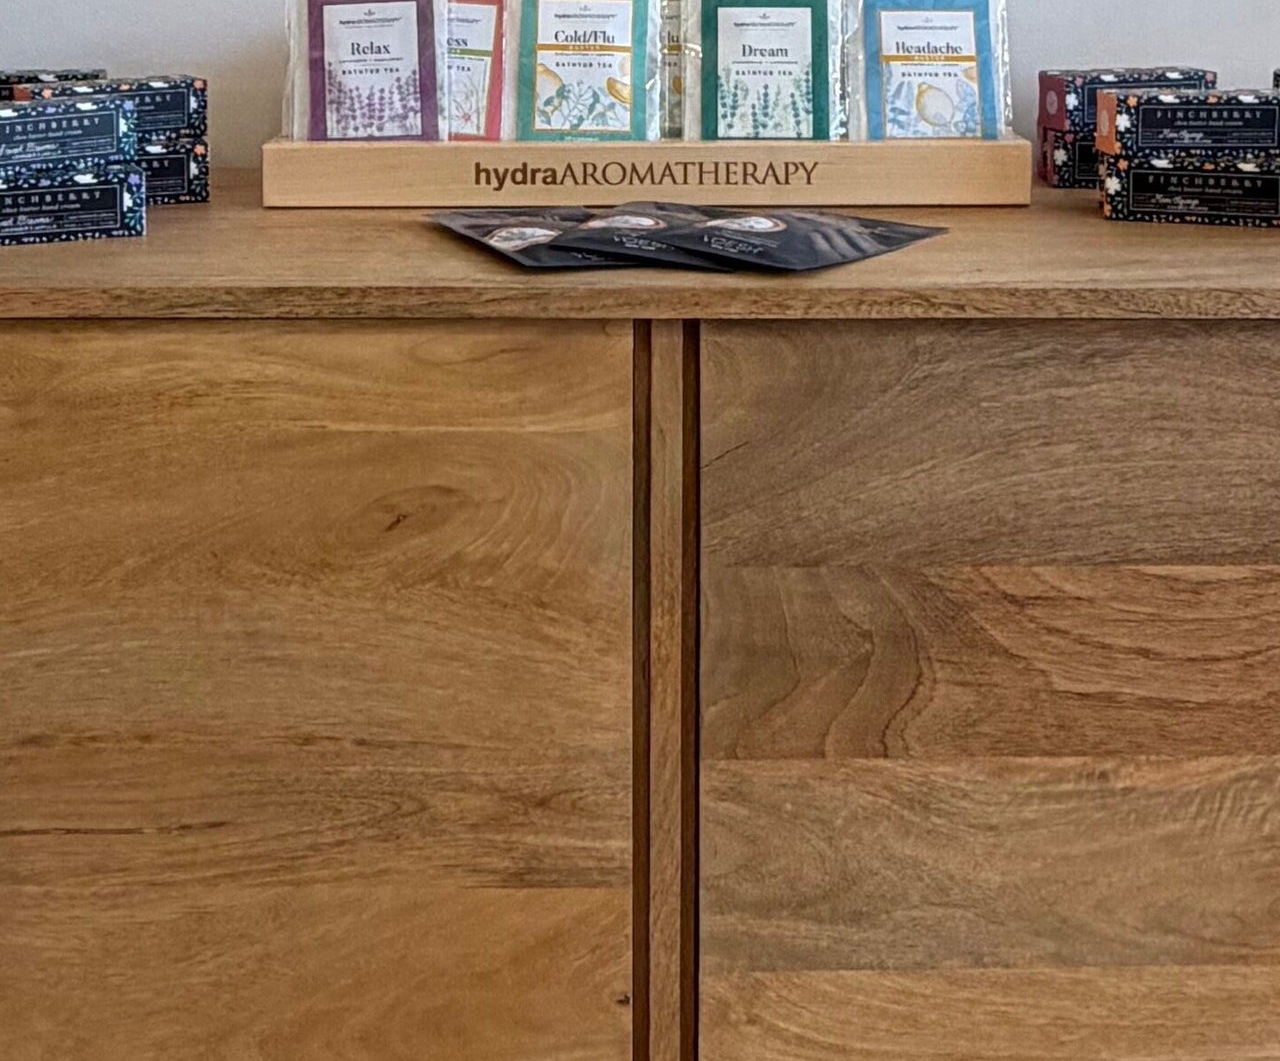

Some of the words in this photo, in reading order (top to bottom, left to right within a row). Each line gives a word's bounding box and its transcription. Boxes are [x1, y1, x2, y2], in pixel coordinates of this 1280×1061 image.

[553, 29, 615, 44] Cold/Flu
[350, 41, 391, 56] Relax
[741, 43, 789, 57] Dream
[895, 41, 963, 55] Headache
[1156, 110, 1262, 119] FINCHBERRY
[473, 160, 819, 192] hydraAROMATHERAPY
[1148, 175, 1263, 188] FINCHBERRY
